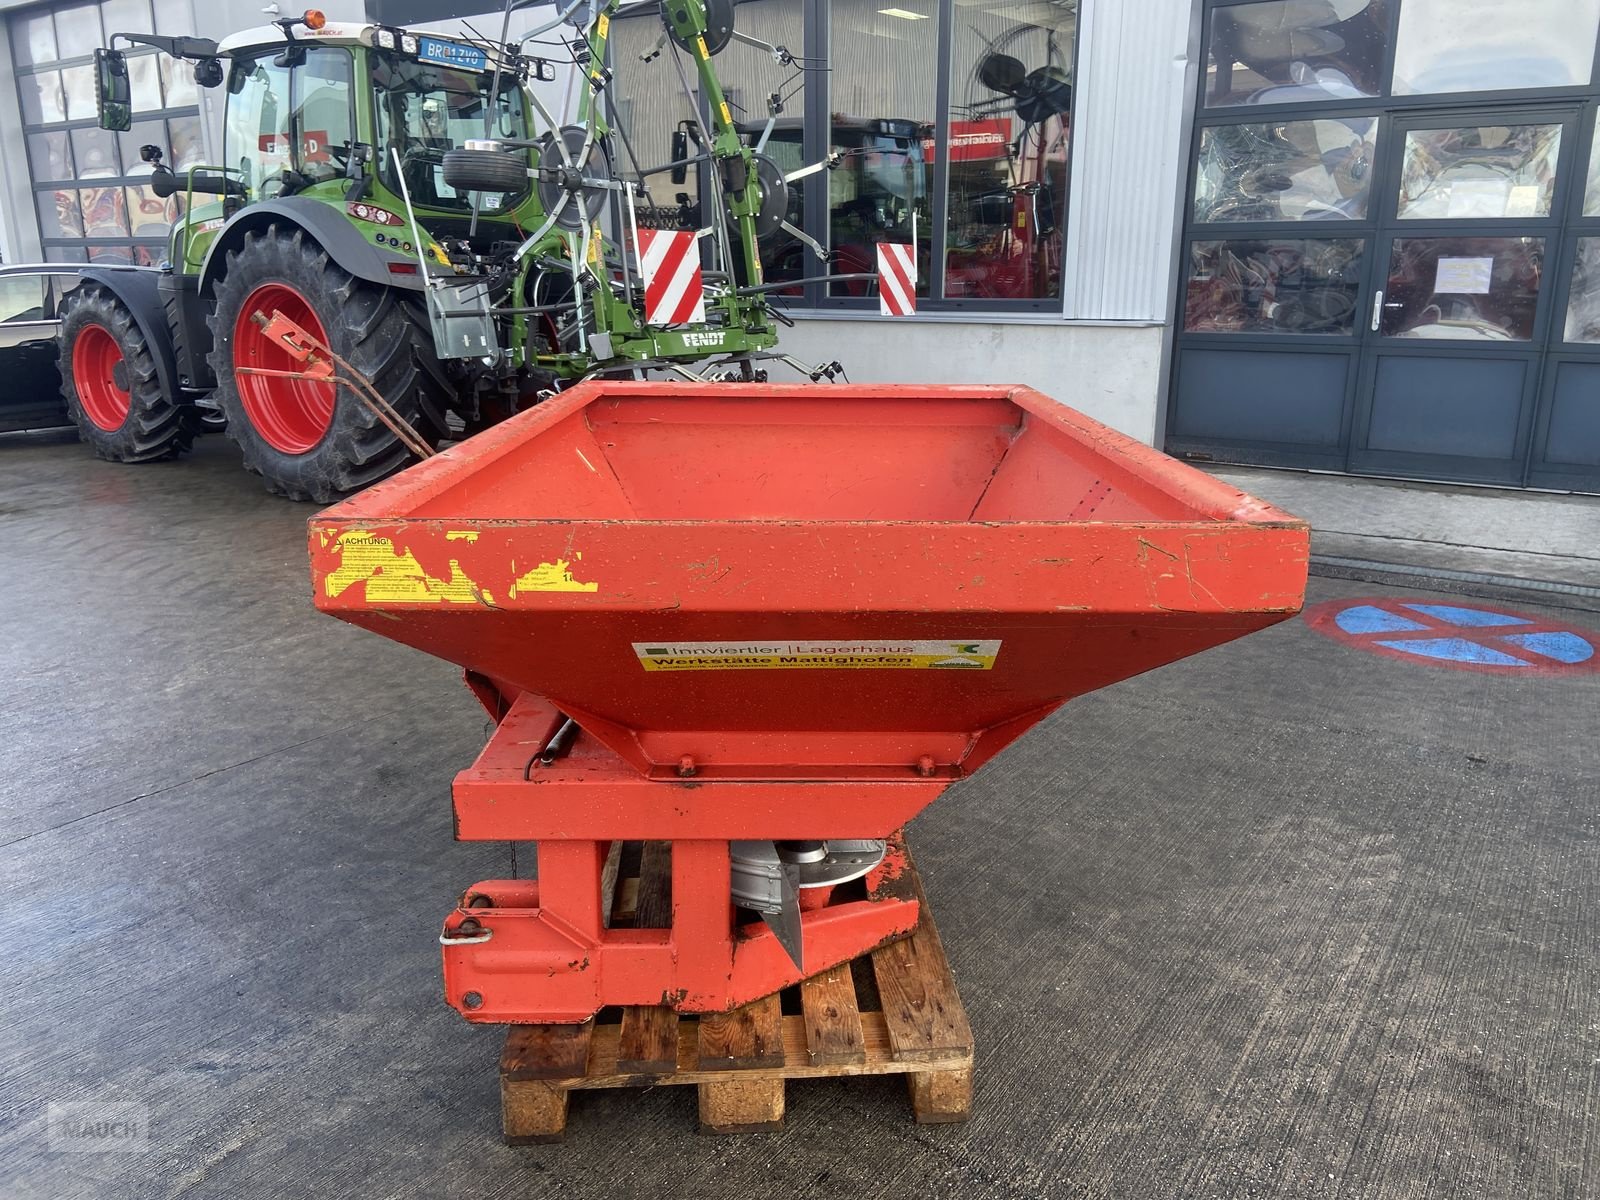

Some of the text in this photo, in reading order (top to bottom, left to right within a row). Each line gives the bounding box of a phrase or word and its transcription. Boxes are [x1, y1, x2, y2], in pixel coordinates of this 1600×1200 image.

[309, 139, 318, 153] D
[681, 331, 726, 347] FENDT
[345, 537, 389, 545] ACHTUNG!
[672, 646, 914, 655] Innviertler Lagerhaus
[652, 656, 912, 665] Werkstätte Mattighofen
